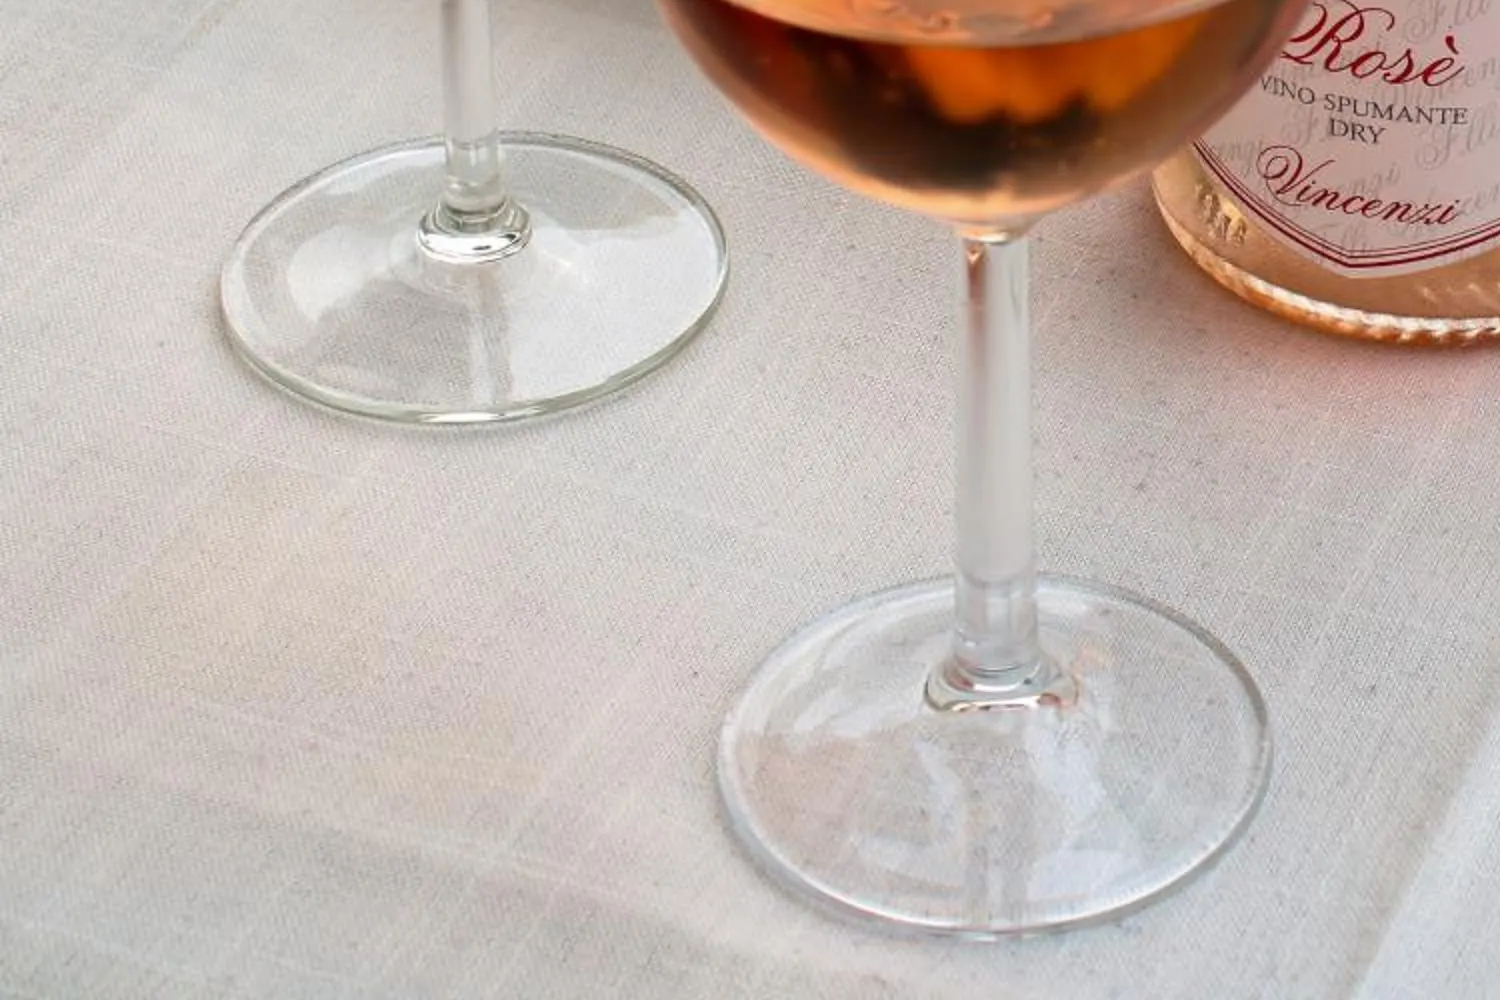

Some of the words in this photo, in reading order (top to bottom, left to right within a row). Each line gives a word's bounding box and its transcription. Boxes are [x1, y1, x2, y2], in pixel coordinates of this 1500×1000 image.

[1260, 75, 1316, 105] VINO
[1323, 93, 1468, 125] SPUMANTE
[1330, 117, 1386, 144] DRY
[1256, 145, 1461, 226] Vincenzi
